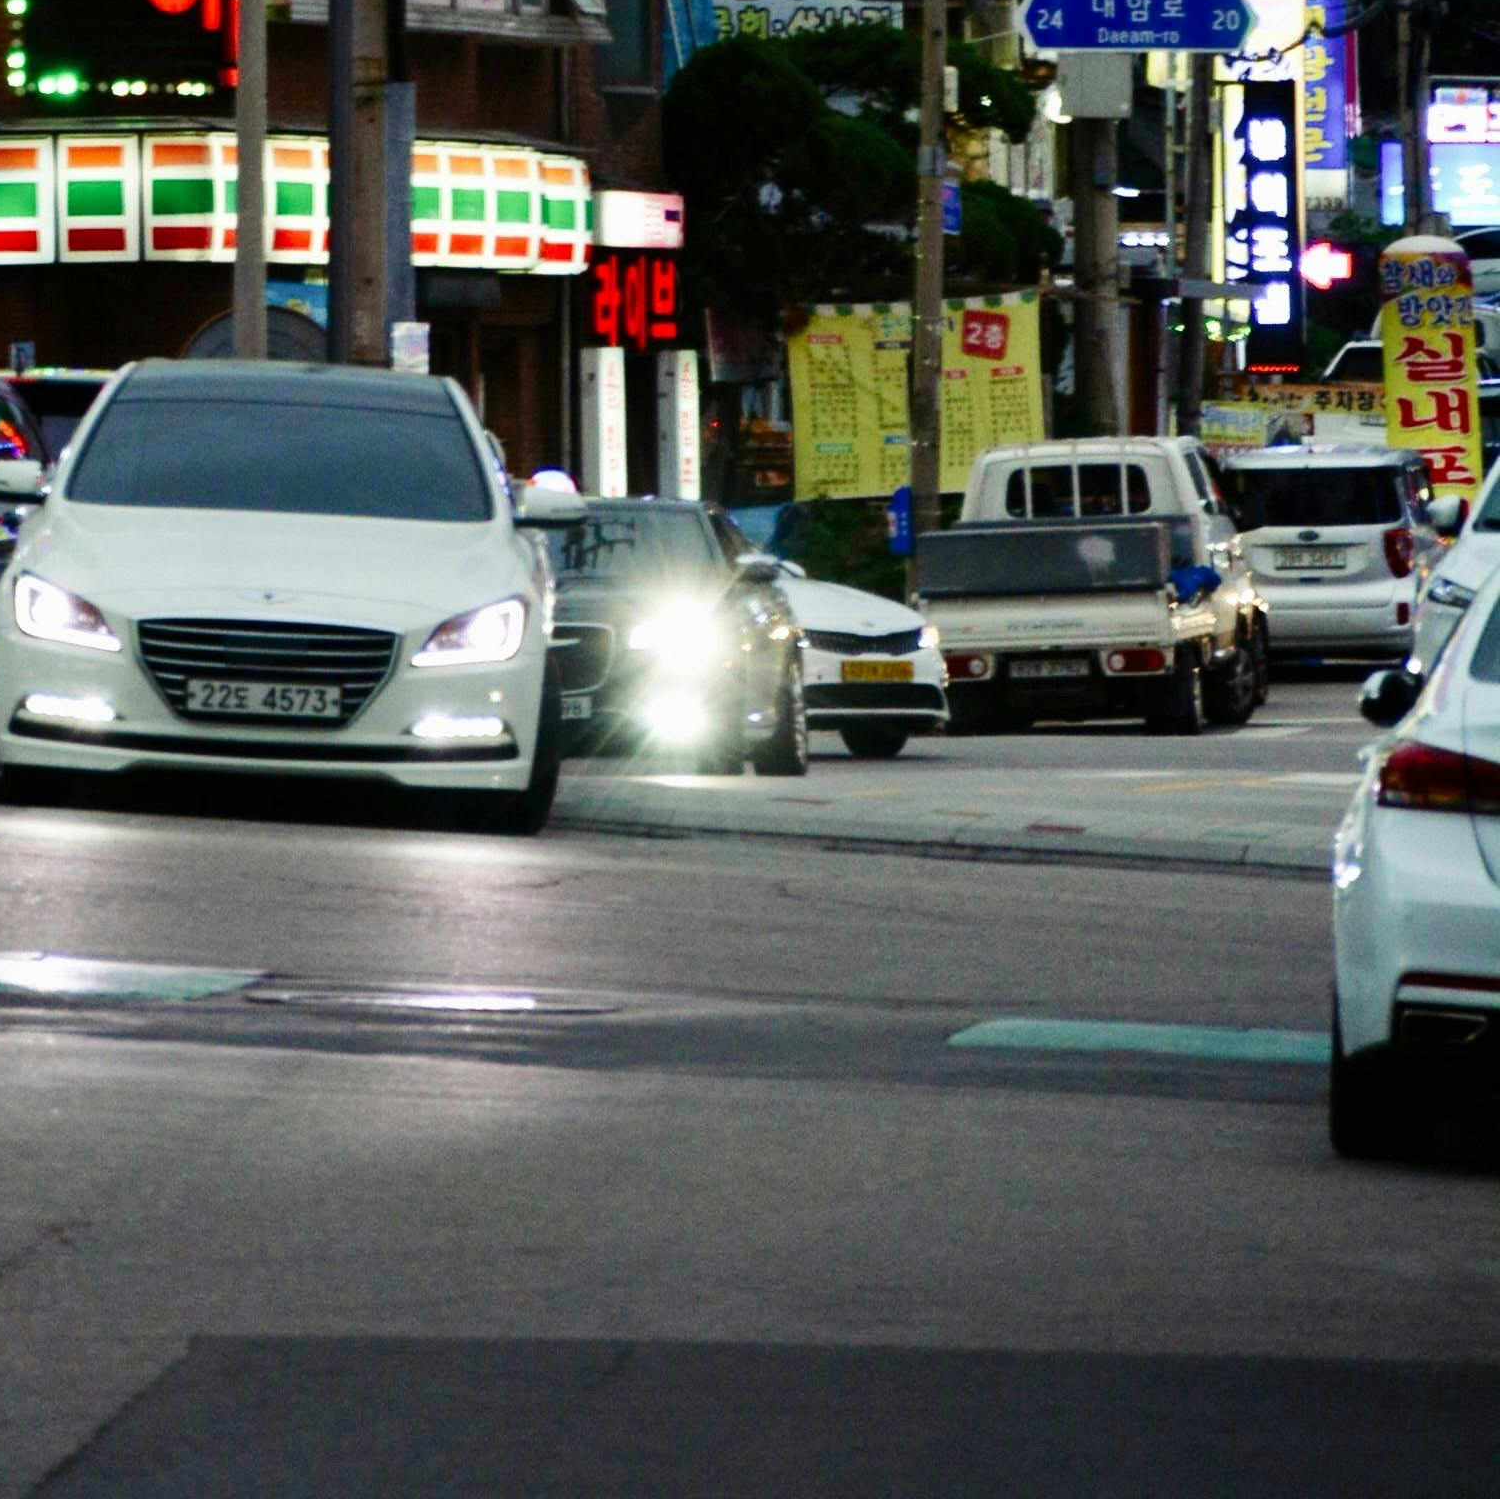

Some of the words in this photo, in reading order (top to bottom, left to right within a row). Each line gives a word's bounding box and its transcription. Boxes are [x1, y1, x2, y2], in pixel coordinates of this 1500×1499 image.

[1036, 9, 1064, 30] 24
[1211, 9, 1241, 31] 20
[1097, 27, 1180, 45] Daeam-ro
[1314, 389, 1376, 413] 주차장
[1394, 330, 1478, 503] 실내포
[261, 686, 328, 713] 4573
